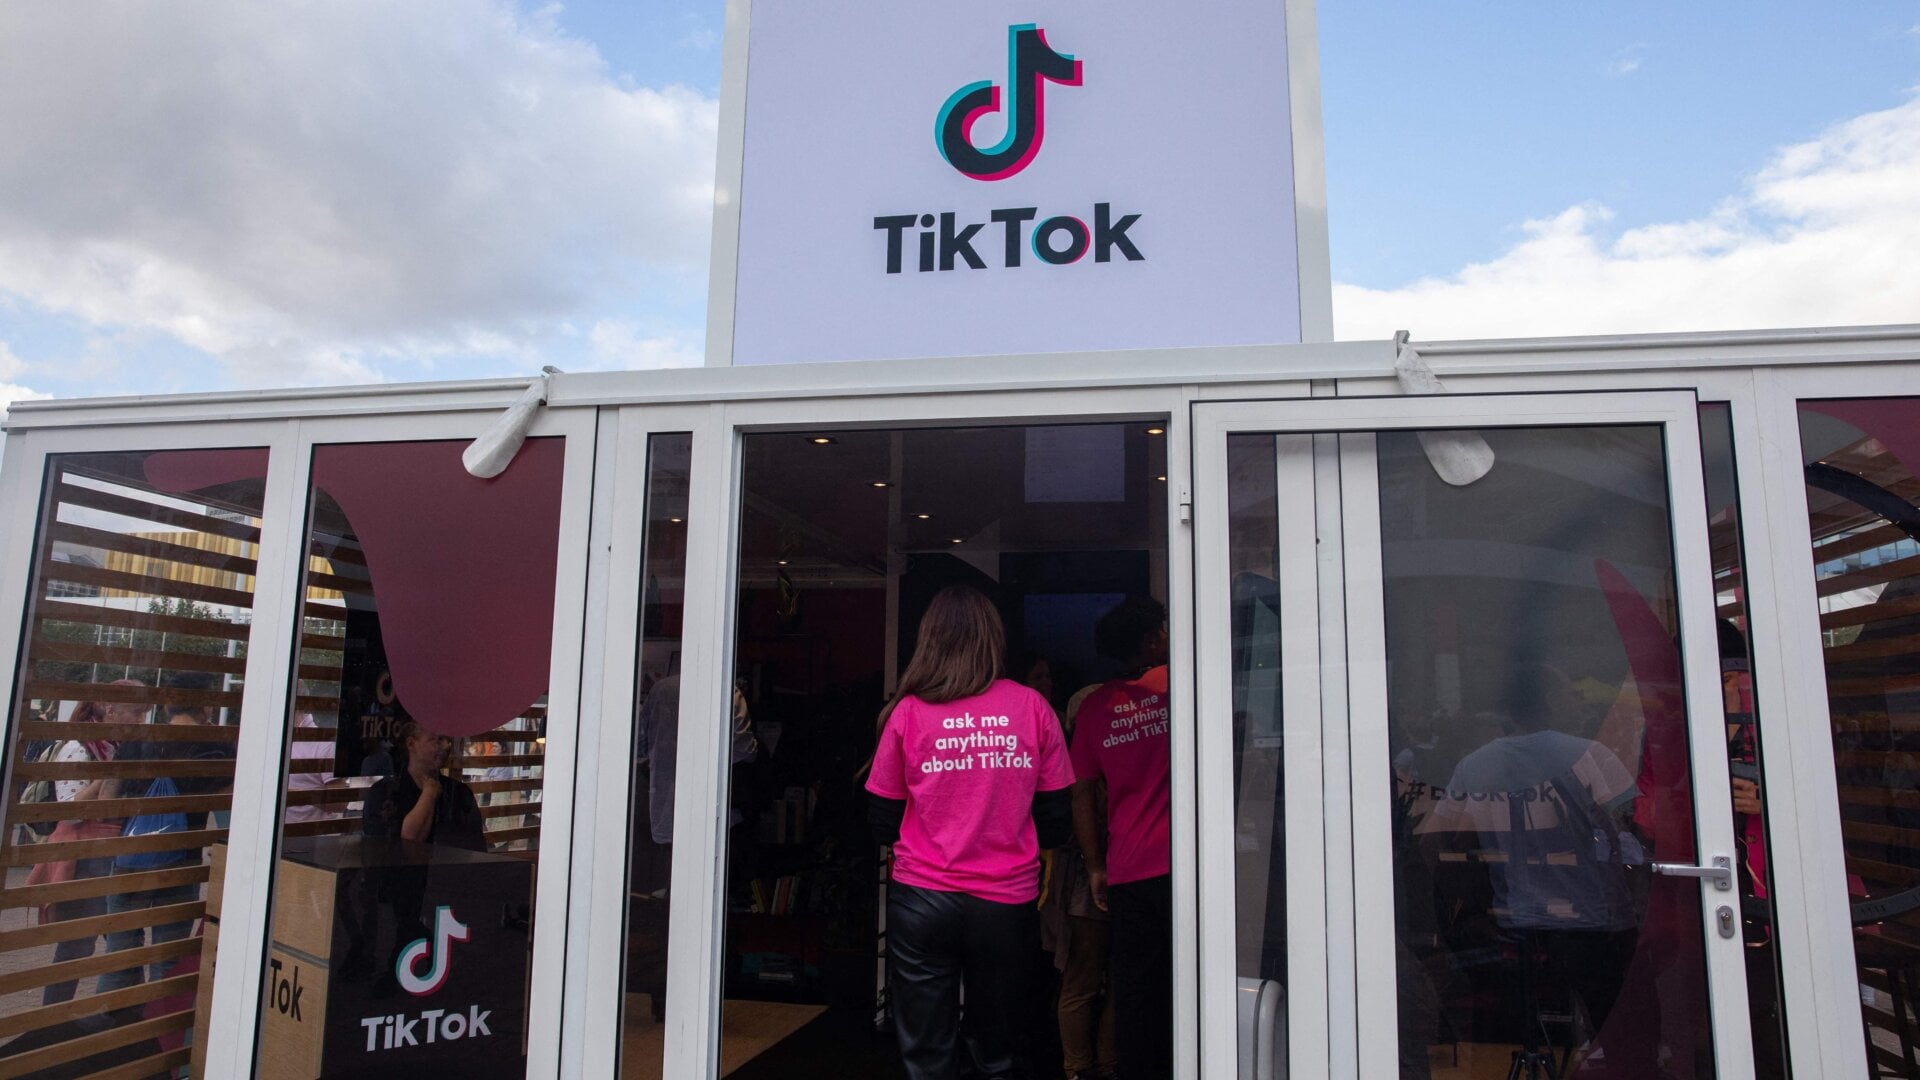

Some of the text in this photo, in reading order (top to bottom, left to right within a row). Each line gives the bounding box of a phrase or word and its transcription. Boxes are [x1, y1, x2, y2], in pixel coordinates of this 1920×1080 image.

[873, 202, 1146, 274] TikTok
[1114, 694, 1159, 713] ask me
[361, 715, 402, 738] TikTo
[942, 712, 1010, 729] ask me
[1111, 707, 1168, 729] anything
[935, 730, 1017, 753] anything
[1103, 721, 1169, 748] about TikT
[921, 751, 1033, 773] about TikTok
[270, 958, 304, 1022] Tok
[360, 1004, 492, 1052] TikTok
